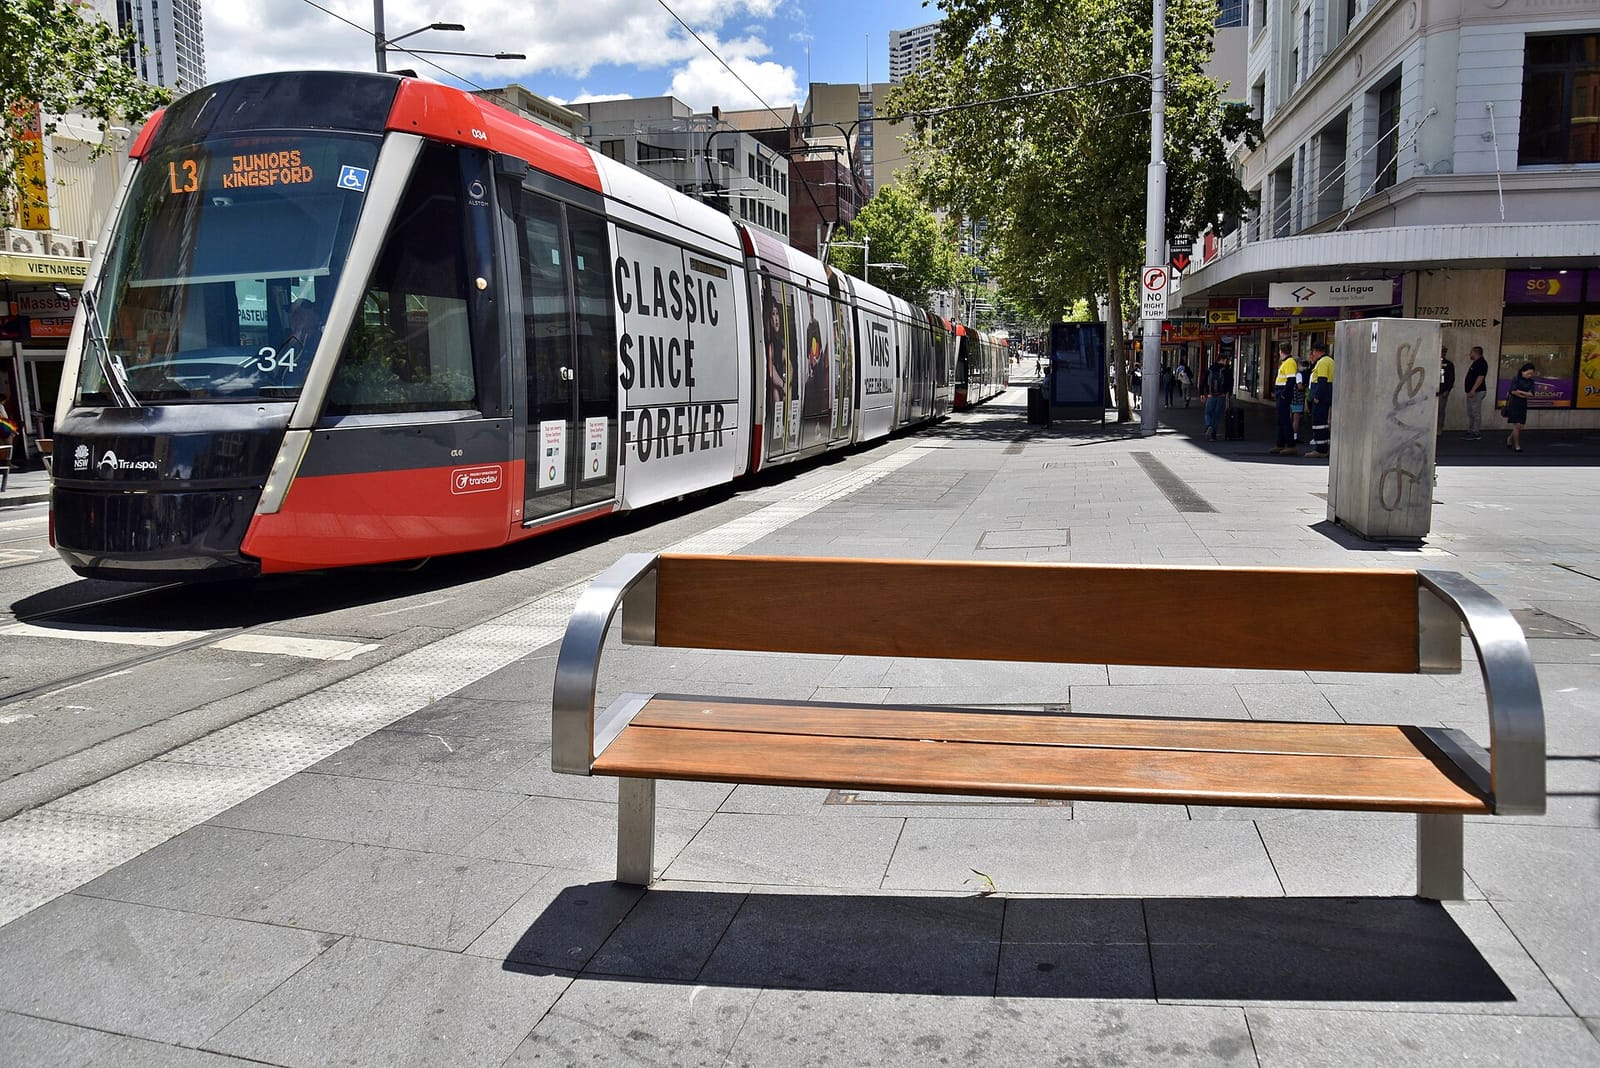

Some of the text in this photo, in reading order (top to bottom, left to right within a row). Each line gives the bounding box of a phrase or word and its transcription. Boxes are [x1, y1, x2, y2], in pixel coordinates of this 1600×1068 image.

[471, 128, 487, 141] 034
[232, 150, 301, 173] JUNIORS
[169, 159, 198, 194] L3
[223, 166, 313, 188] KINGSFORD
[28, 263, 87, 276] VIETNAMESE
[615, 256, 719, 327] CLASSIC
[1147, 292, 1162, 301] NO
[1329, 284, 1374, 294] La Lingua
[20, 296, 79, 311] Massage
[1417, 306, 1450, 315] 770-772
[1441, 318, 1487, 328] ENTRANCE
[866, 320, 889, 368] VANS
[256, 346, 298, 372] 34
[619, 333, 695, 390] SINCE
[619, 404, 724, 466] FOREVER
[74, 459, 88, 468] NSW
